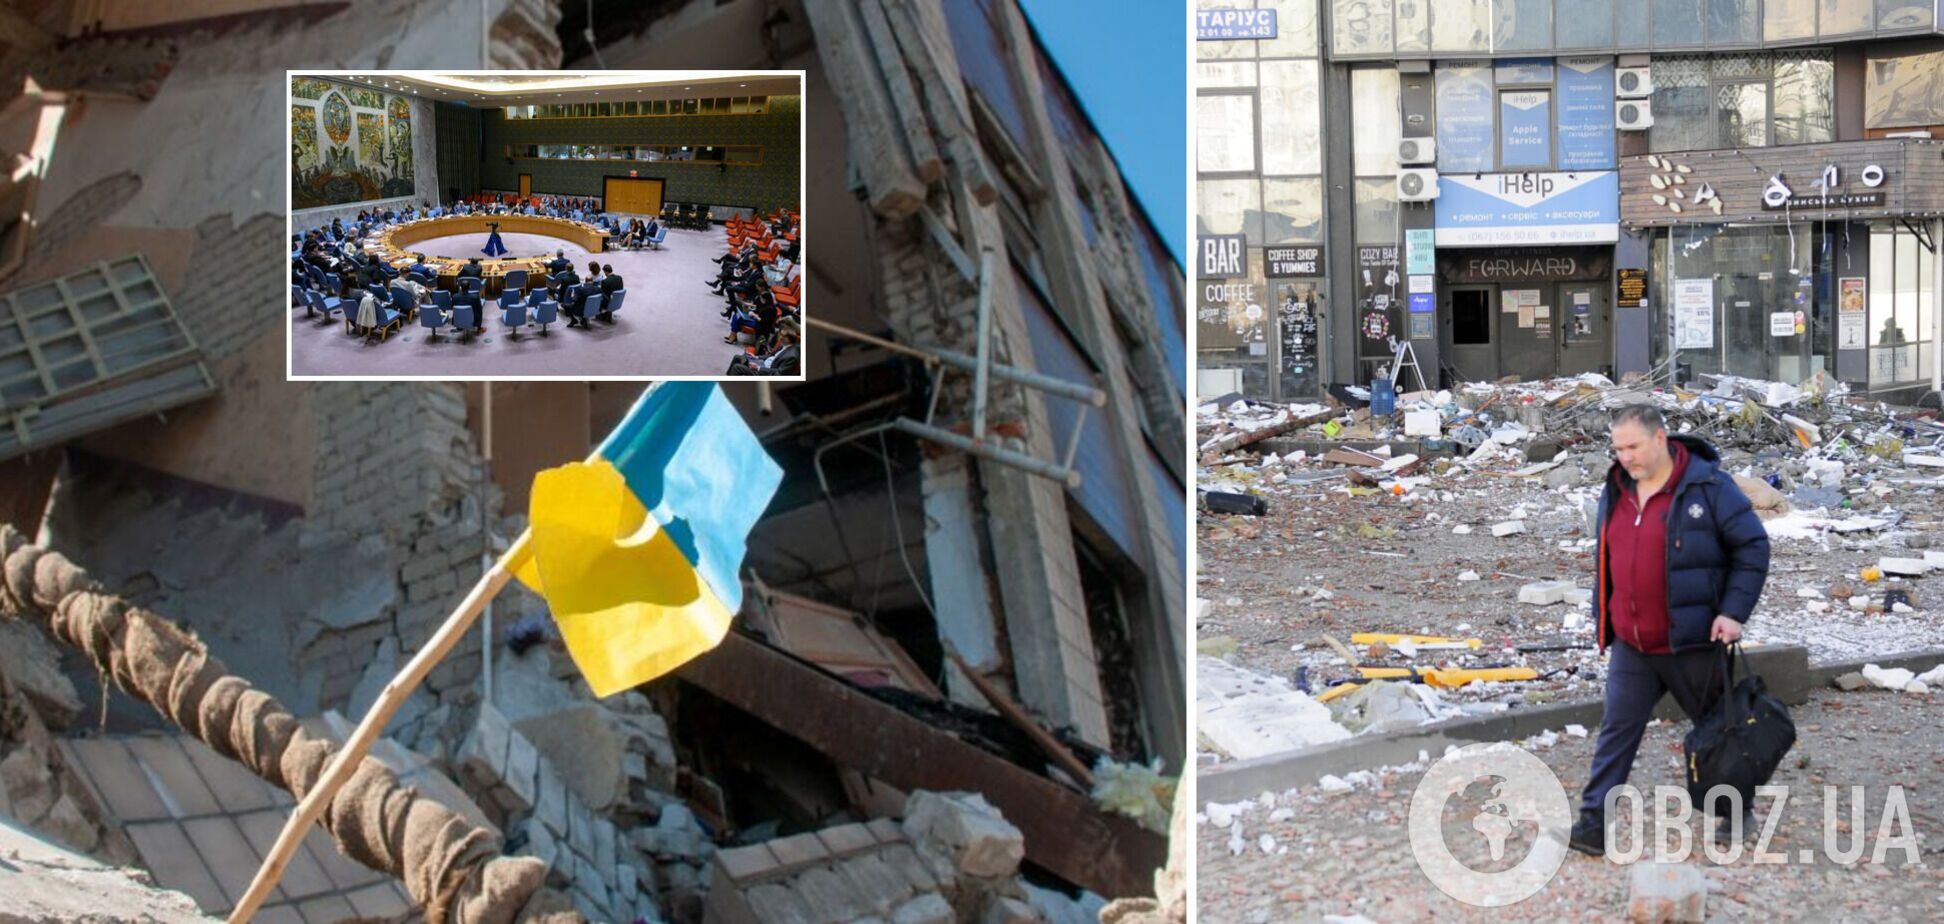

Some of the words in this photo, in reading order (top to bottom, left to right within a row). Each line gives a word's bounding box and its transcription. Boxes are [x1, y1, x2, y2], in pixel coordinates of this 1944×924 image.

[1513, 95, 1537, 105] iHelp
[1513, 125, 1538, 135] Apple
[1508, 136, 1543, 145] Service
[1498, 174, 1554, 198] iHelp
[1459, 213, 1493, 222] ремонт
[1508, 211, 1538, 221] сервіс
[1552, 210, 1600, 220] аксесуари
[1204, 238, 1240, 274] BAR
[1268, 249, 1295, 260] COFFEE
[1297, 248, 1318, 260] SHOP
[1360, 248, 1381, 260] COZY
[1382, 248, 1399, 259] BAR
[1281, 262, 1316, 273] YUMMIES
[1469, 258, 1576, 278] FORWARD
[1205, 284, 1254, 302] COFFEE
